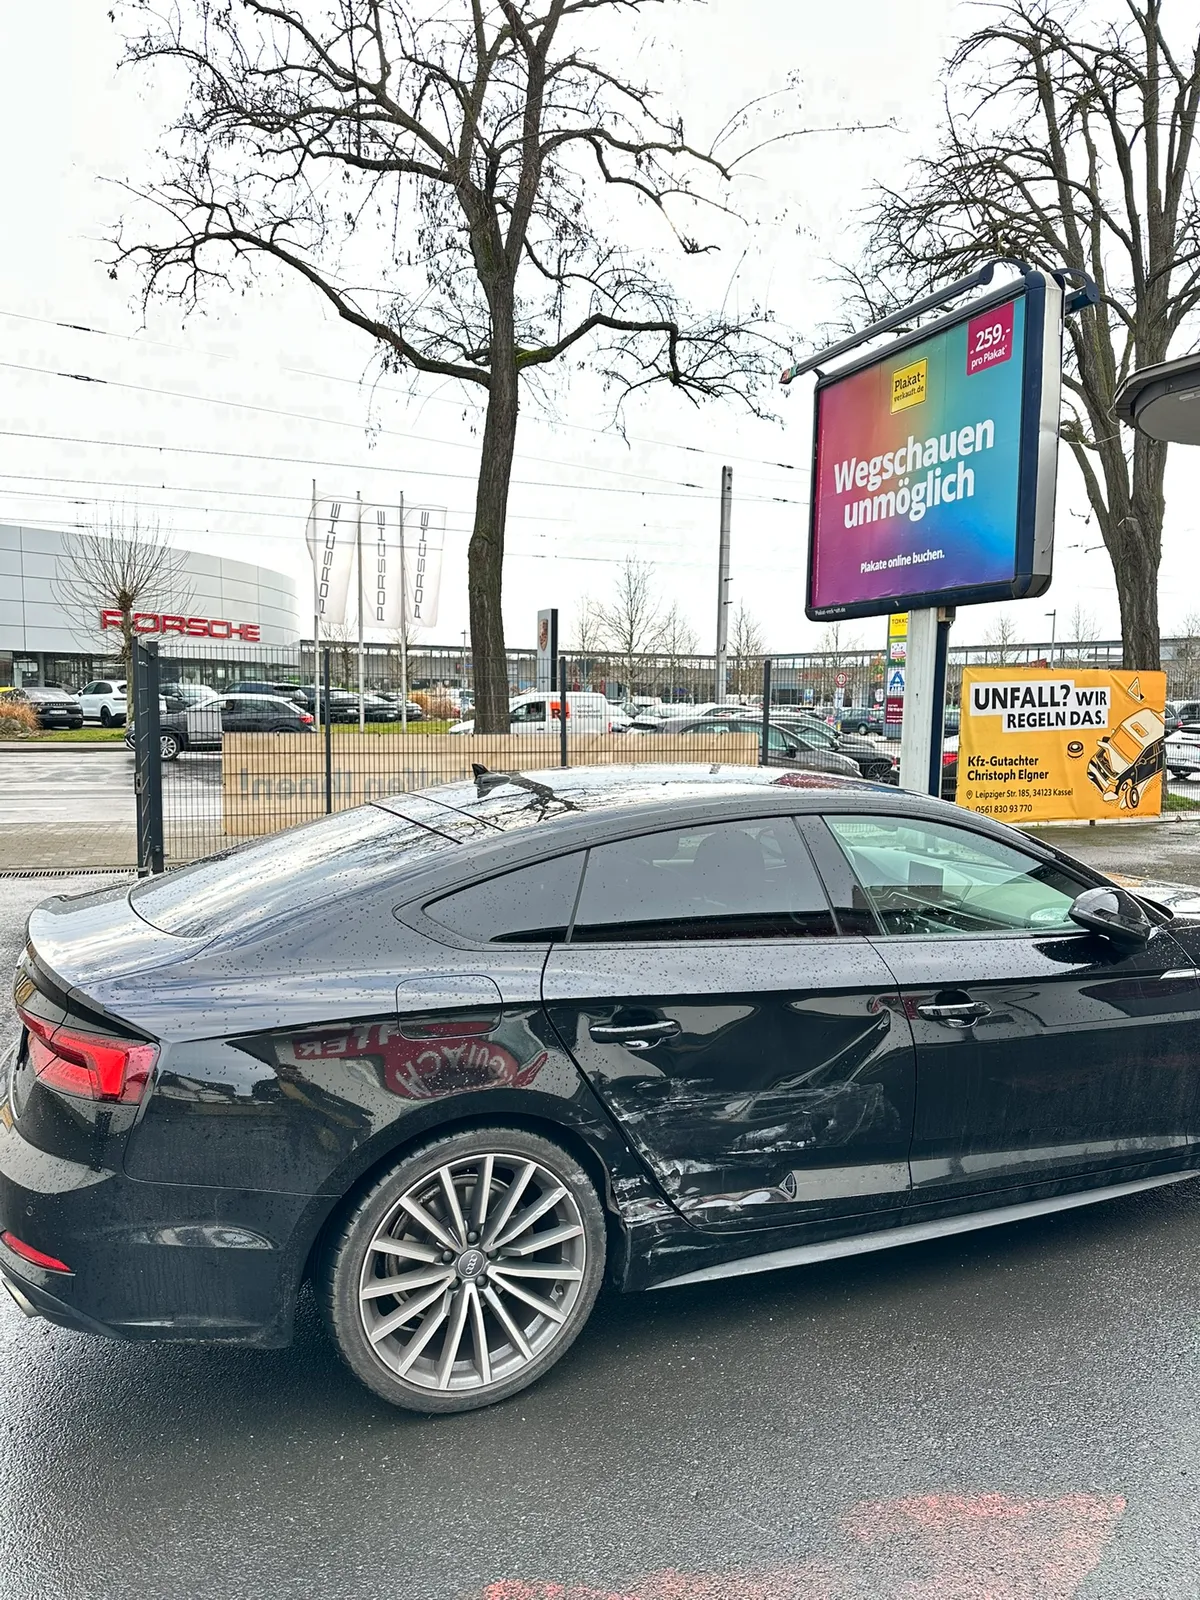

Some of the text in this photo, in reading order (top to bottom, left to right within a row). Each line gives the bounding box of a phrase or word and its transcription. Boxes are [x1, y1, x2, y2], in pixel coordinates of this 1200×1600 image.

[971, 357, 983, 371] pro
[894, 371, 925, 392] Plakat-
[833, 418, 995, 494] Wegschauen
[844, 460, 975, 529] unmöglich
[376, 510, 386, 622] PORSCHE
[413, 511, 430, 619] PORSCHE
[860, 548, 945, 574] Plakate online buchen.
[100, 609, 261, 642] PORSCHE
[974, 684, 1107, 710] UNFALL? WIR
[1007, 710, 1105, 729] REGELN DAS.
[967, 755, 1039, 767] Kfz-Gutachter
[967, 768, 1049, 783] Christoph Elgner
[975, 787, 1074, 800] Leipziger Str. 185, 34123 Kassel
[975, 804, 1033, 814] 0561 830 93 770
